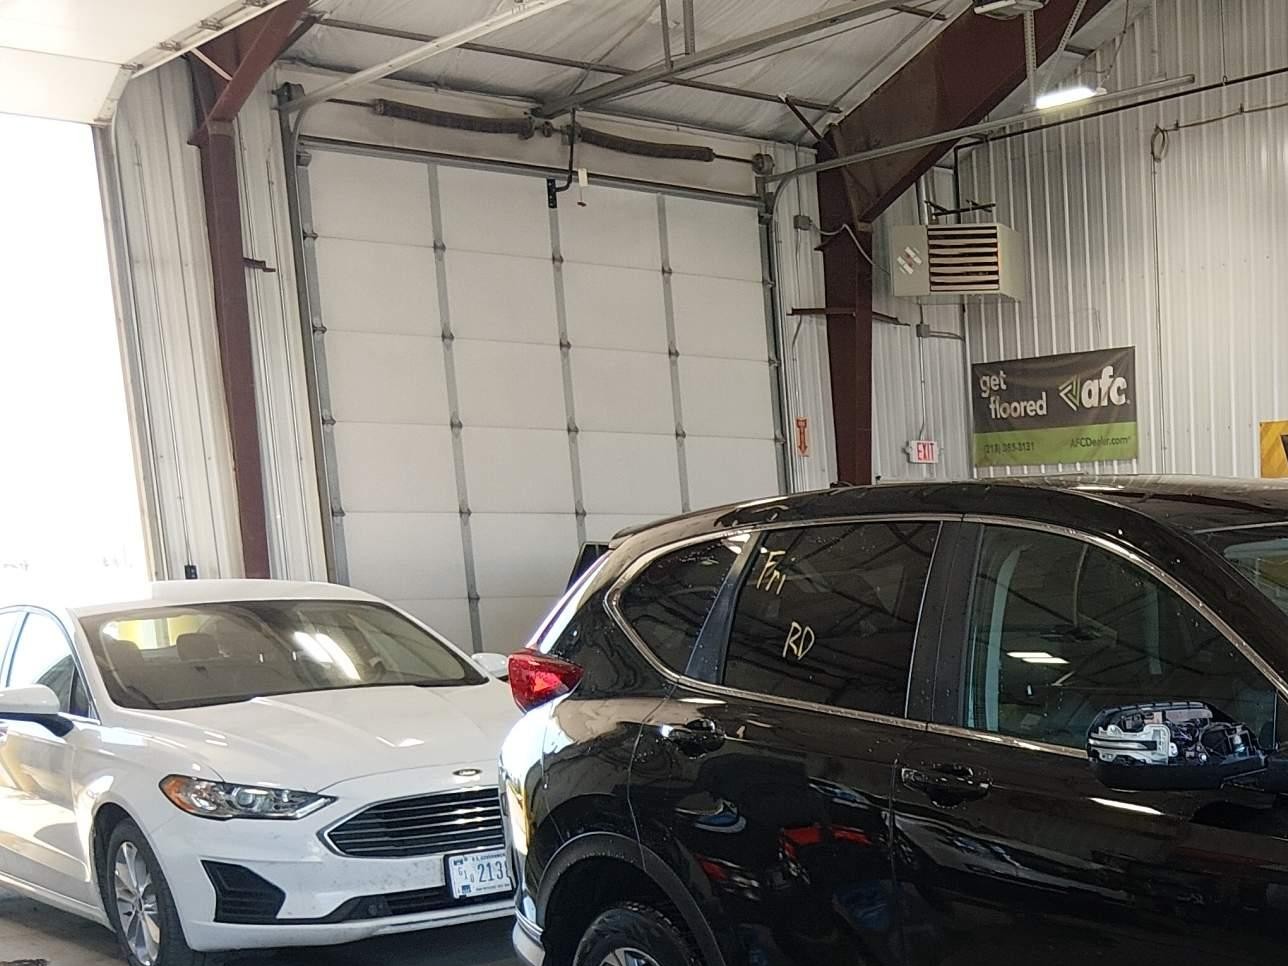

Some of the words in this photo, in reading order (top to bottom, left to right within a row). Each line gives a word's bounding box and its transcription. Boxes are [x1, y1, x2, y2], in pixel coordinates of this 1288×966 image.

[979, 370, 1008, 398] get
[1081, 365, 1128, 409] afc
[989, 391, 1047, 420] floored
[917, 442, 934, 460] EXIT
[782, 620, 815, 661] RD
